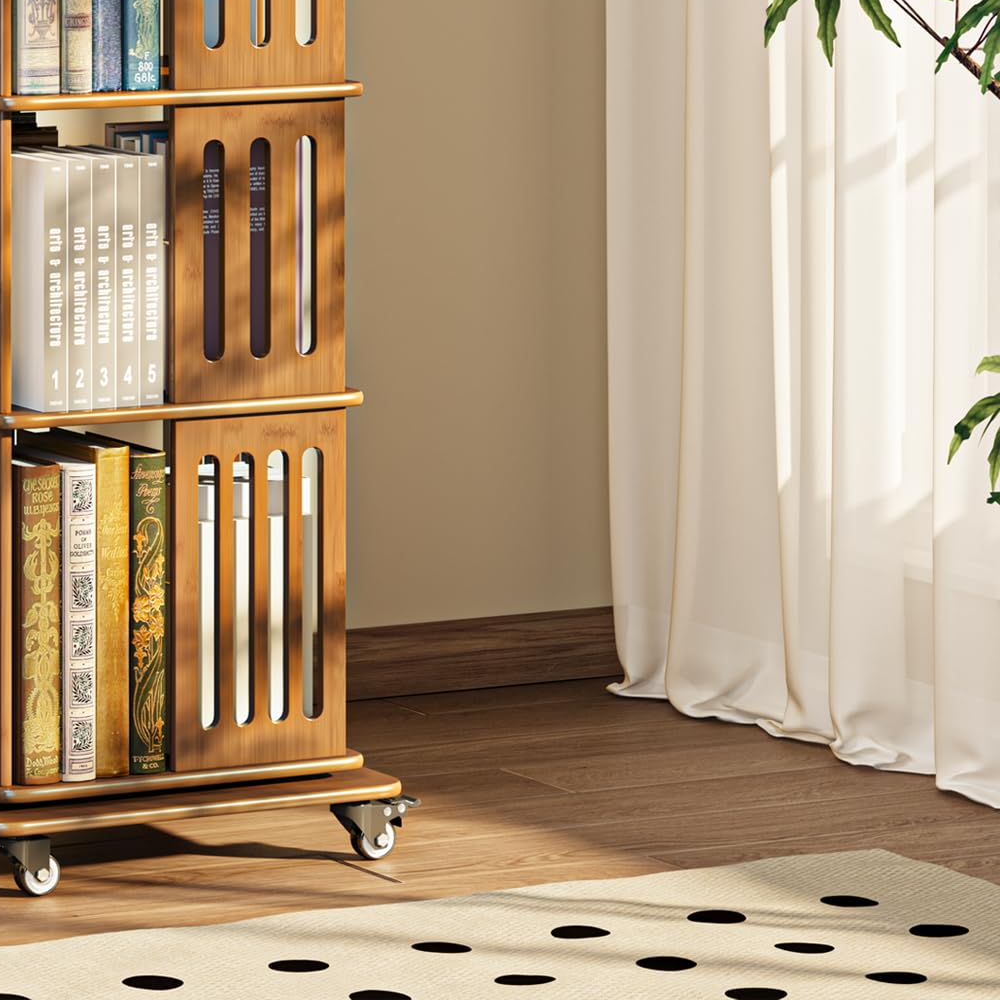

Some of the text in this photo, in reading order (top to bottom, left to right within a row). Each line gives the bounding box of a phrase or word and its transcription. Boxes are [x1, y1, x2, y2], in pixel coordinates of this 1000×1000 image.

[51, 369, 59, 390] 1
[75, 368, 85, 388] 2
[99, 367, 109, 387] 3
[123, 365, 132, 385] 4
[147, 363, 157, 383] 5
